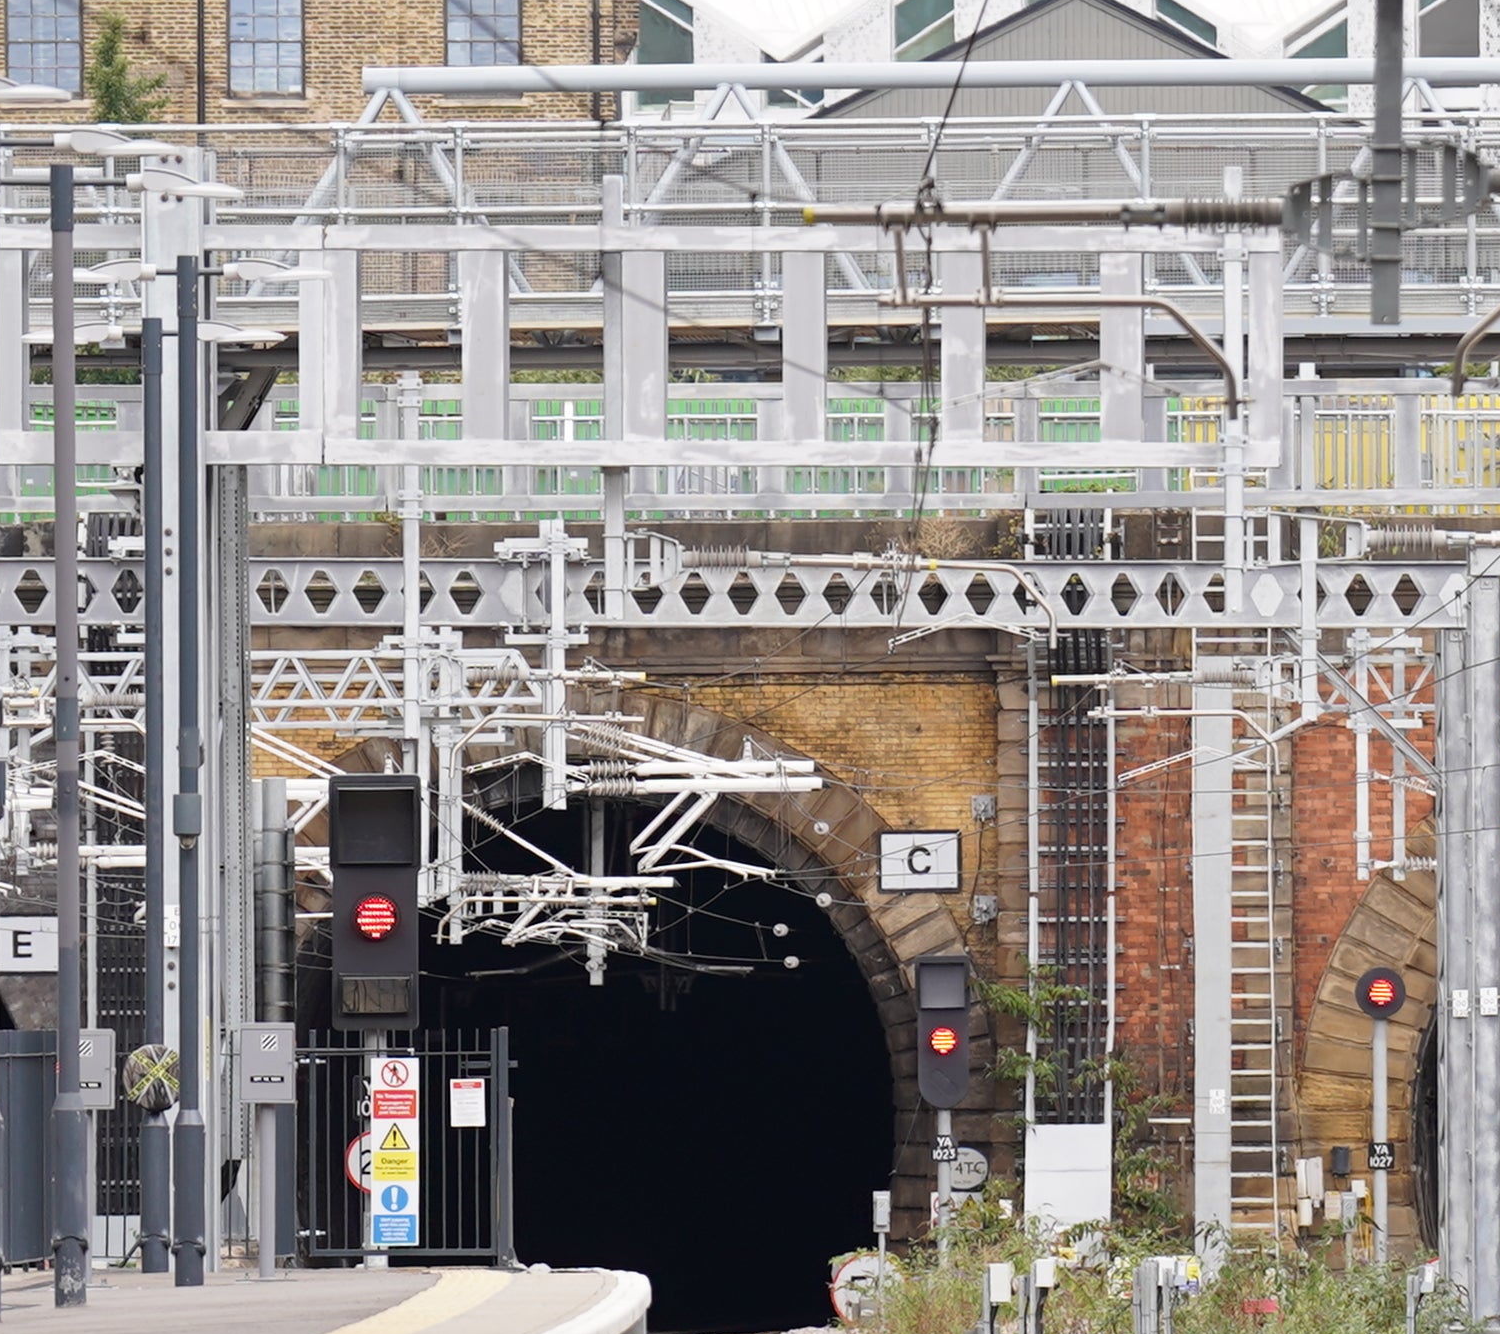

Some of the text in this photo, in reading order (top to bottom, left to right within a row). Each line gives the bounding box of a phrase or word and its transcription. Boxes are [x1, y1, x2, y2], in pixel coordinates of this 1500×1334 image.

[907, 846, 932, 875] C
[12, 931, 32, 958] E
[937, 1136, 953, 1147] YA
[932, 1148, 956, 1160] 1023
[1374, 1144, 1389, 1155] YA
[1369, 1155, 1393, 1168] 1027
